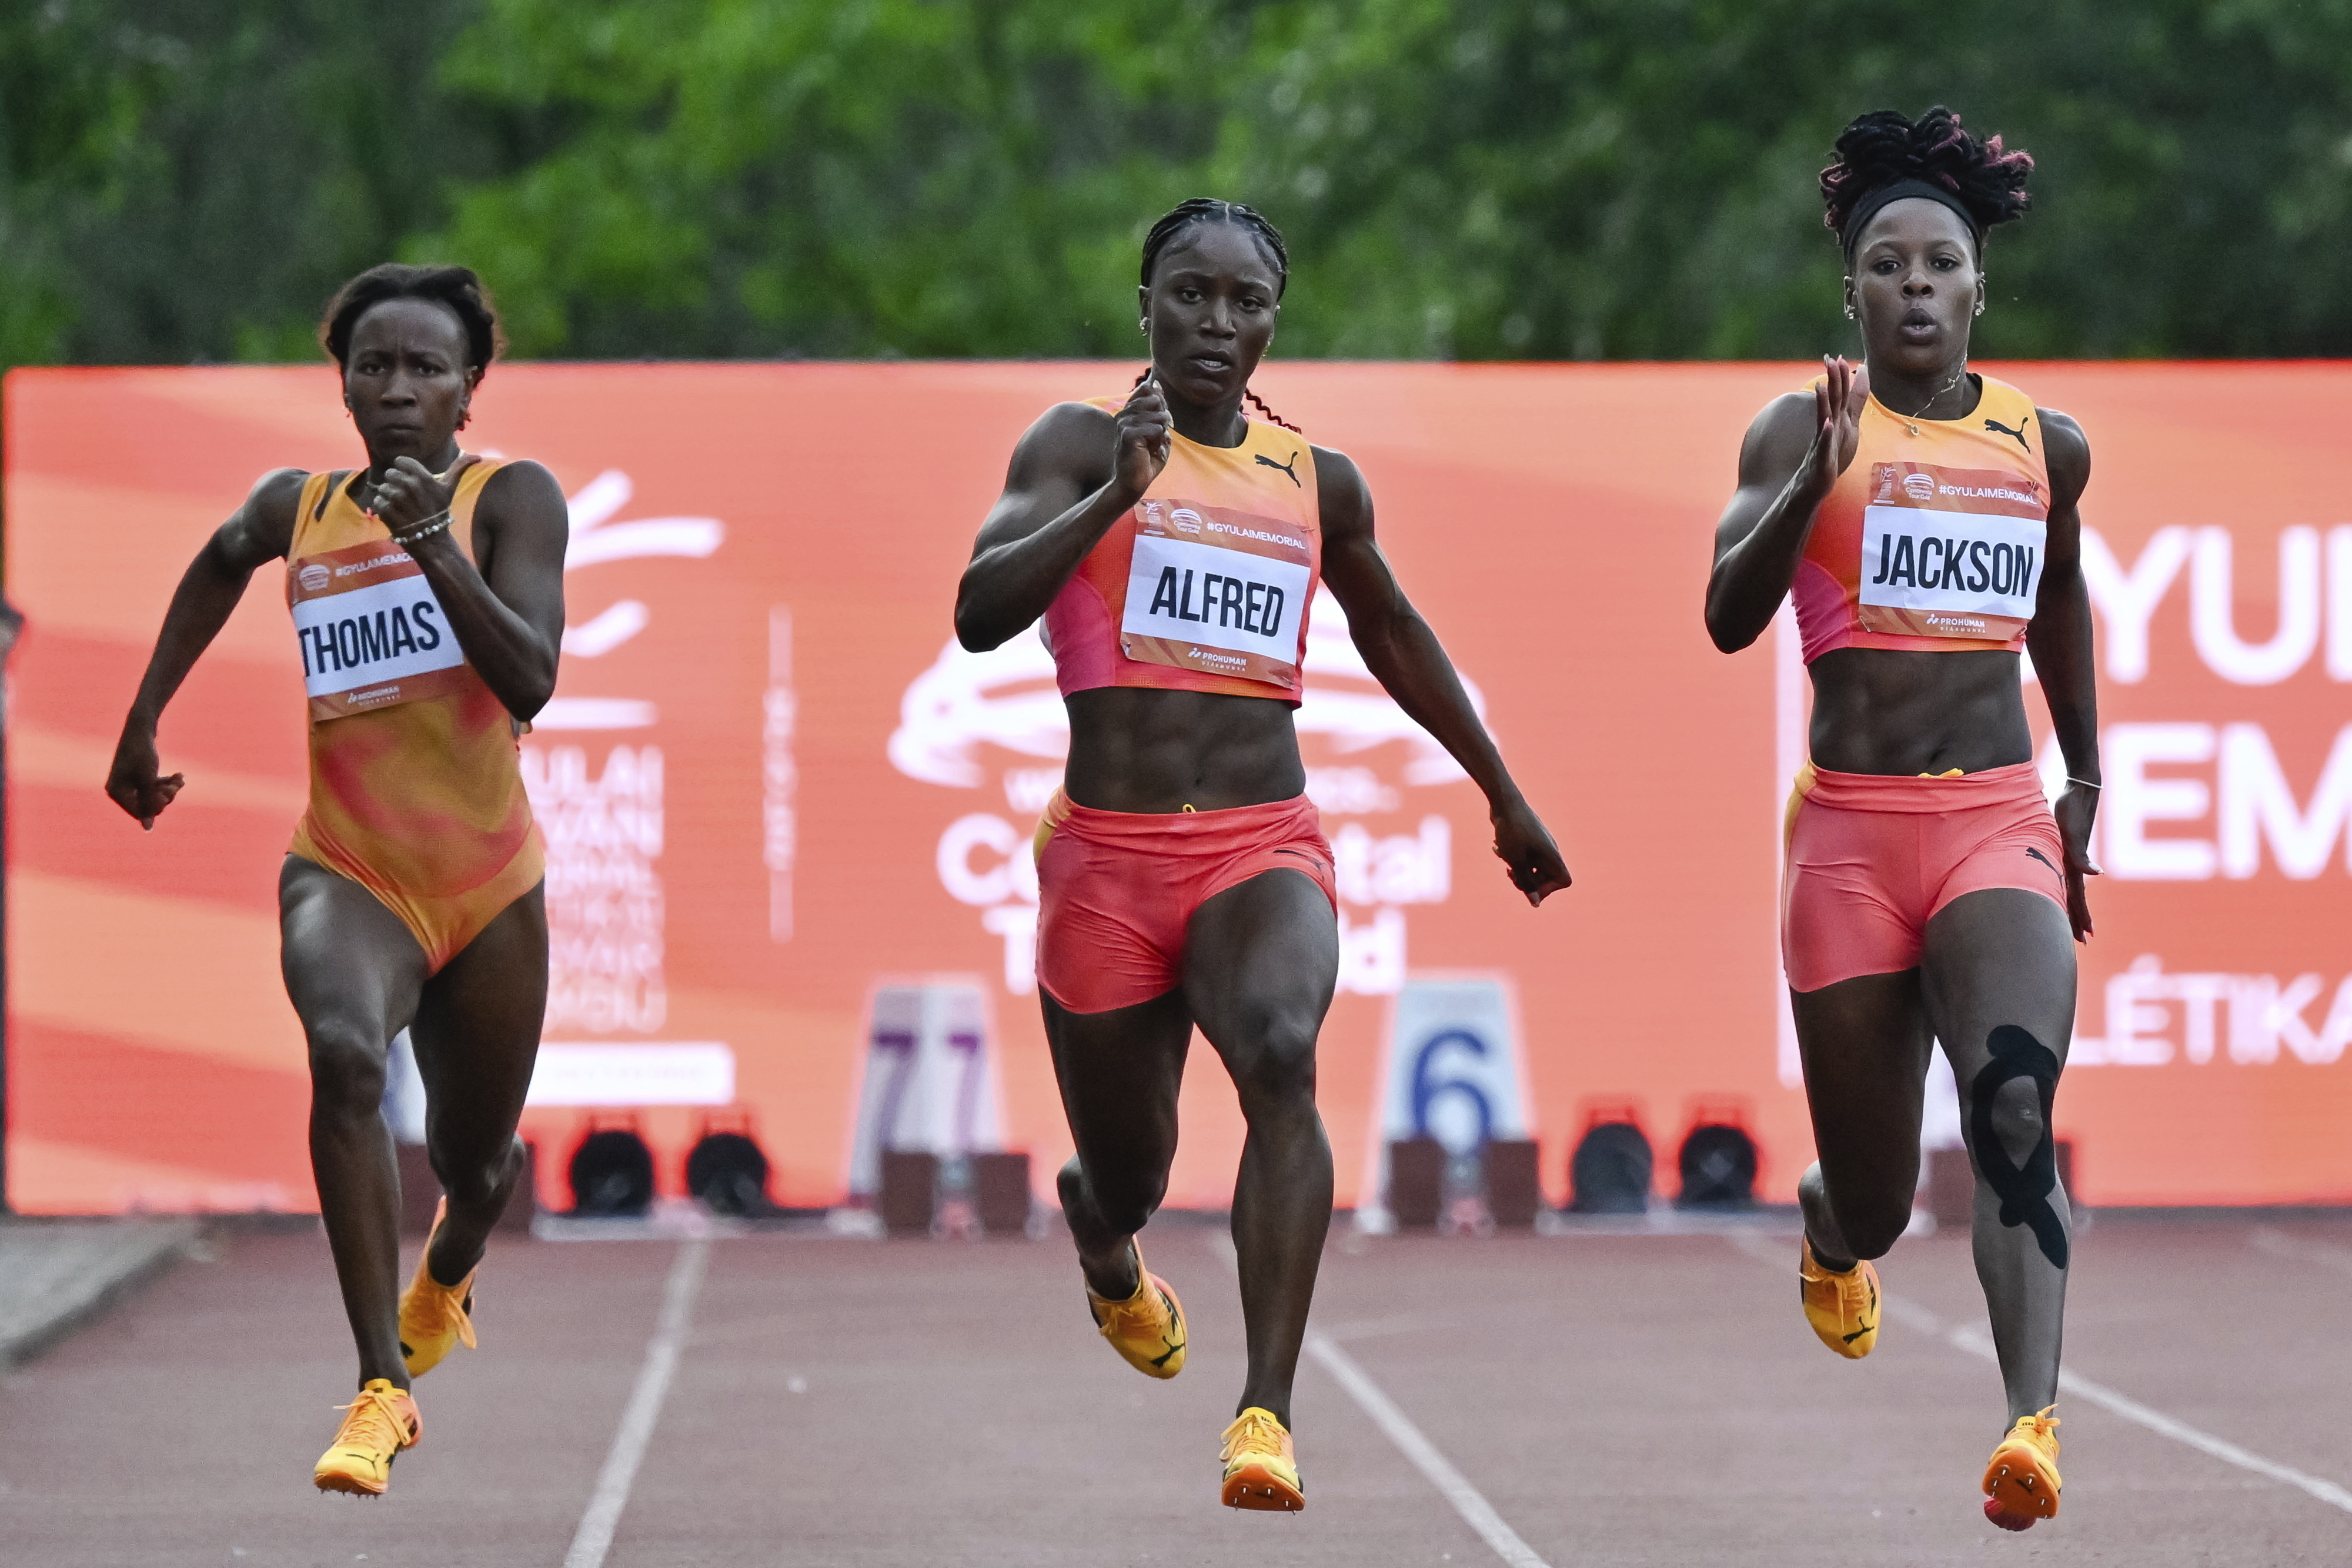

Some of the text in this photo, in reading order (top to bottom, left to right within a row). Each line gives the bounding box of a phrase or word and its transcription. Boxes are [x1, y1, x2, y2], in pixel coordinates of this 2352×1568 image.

[1939, 484, 2037, 505] #GYULAIMEMORIAL
[1207, 521, 1306, 550] #GYULAIMEMORIAL
[1872, 533, 2034, 597] JACKSON
[1149, 566, 1285, 637] ALFRED
[1940, 617, 1985, 628] PROHUMAN
[299, 601, 440, 677] THOMAS
[1202, 652, 1247, 666] PROHUMAN
[1413, 1027, 1490, 1154] 6
